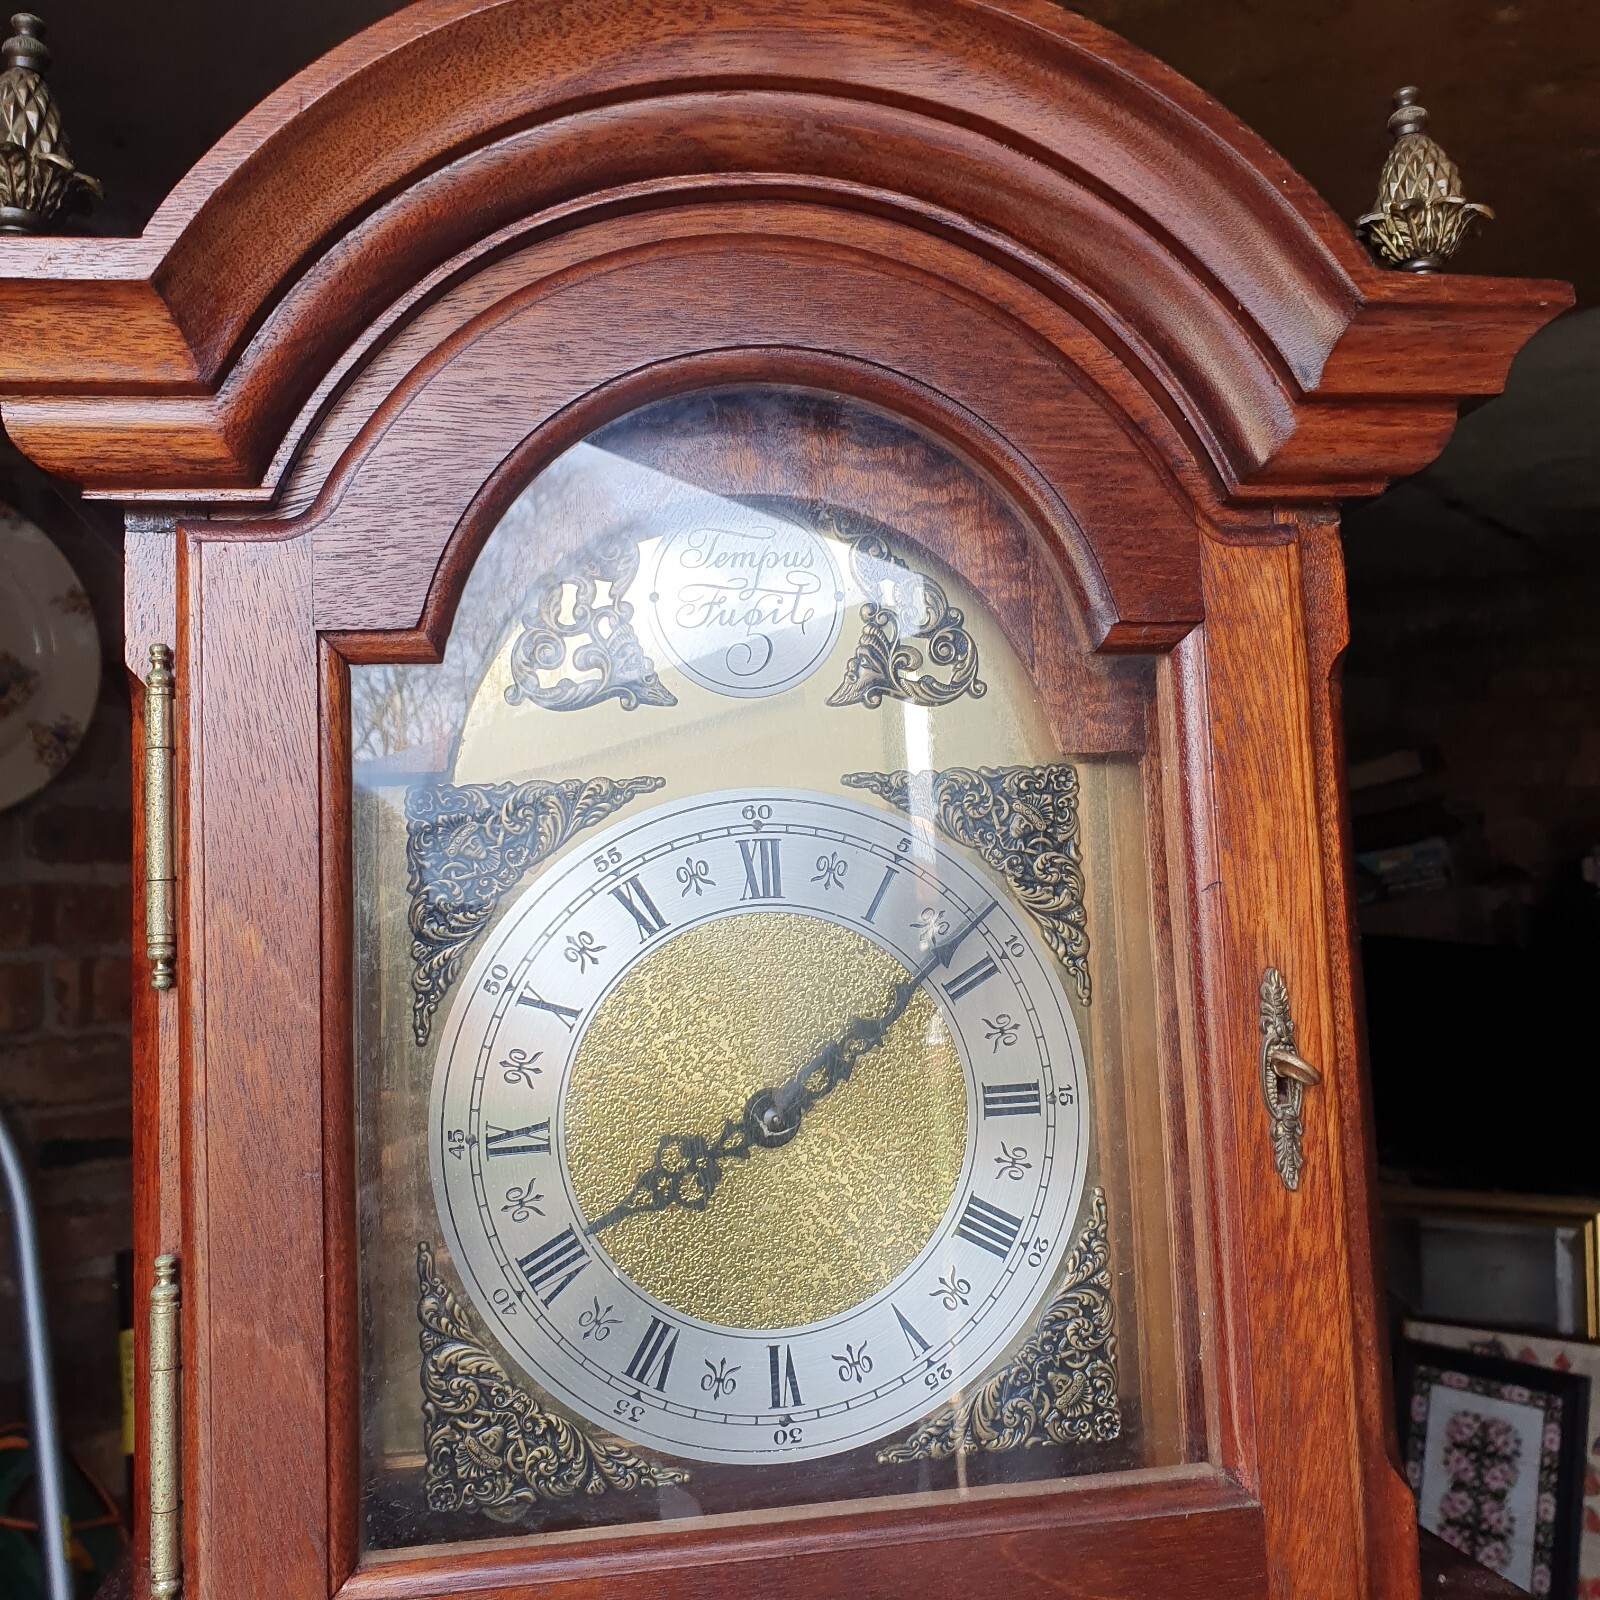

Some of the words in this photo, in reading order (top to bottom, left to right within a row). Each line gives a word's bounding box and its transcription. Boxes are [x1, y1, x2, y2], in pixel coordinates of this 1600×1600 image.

[679, 525, 815, 600] Tempus
[675, 570, 821, 676] Fugit
[741, 804, 773, 821] 60
[592, 846, 623, 873] 55
[896, 837, 913, 853] 5
[735, 838, 785, 901] XII
[607, 873, 671, 944] XI
[1003, 933, 1025, 958] 10
[482, 963, 509, 996] 50
[940, 950, 1002, 1006] II
[514, 980, 583, 1033] X
[981, 1079, 1042, 1120] III
[1058, 1083, 1074, 1107] 15
[447, 1128, 466, 1160] 45
[485, 1117, 551, 1162] IX
[951, 1190, 1025, 1263] IIII
[514, 1222, 593, 1310] VIII
[1028, 1238, 1050, 1268] 20
[492, 1288, 518, 1317] 40
[891, 1302, 935, 1362] V
[621, 1315, 681, 1394] VII
[765, 1343, 806, 1410] VI
[924, 1362, 953, 1391] 25
[614, 1400, 646, 1423] 35
[773, 1427, 803, 1445] 30
